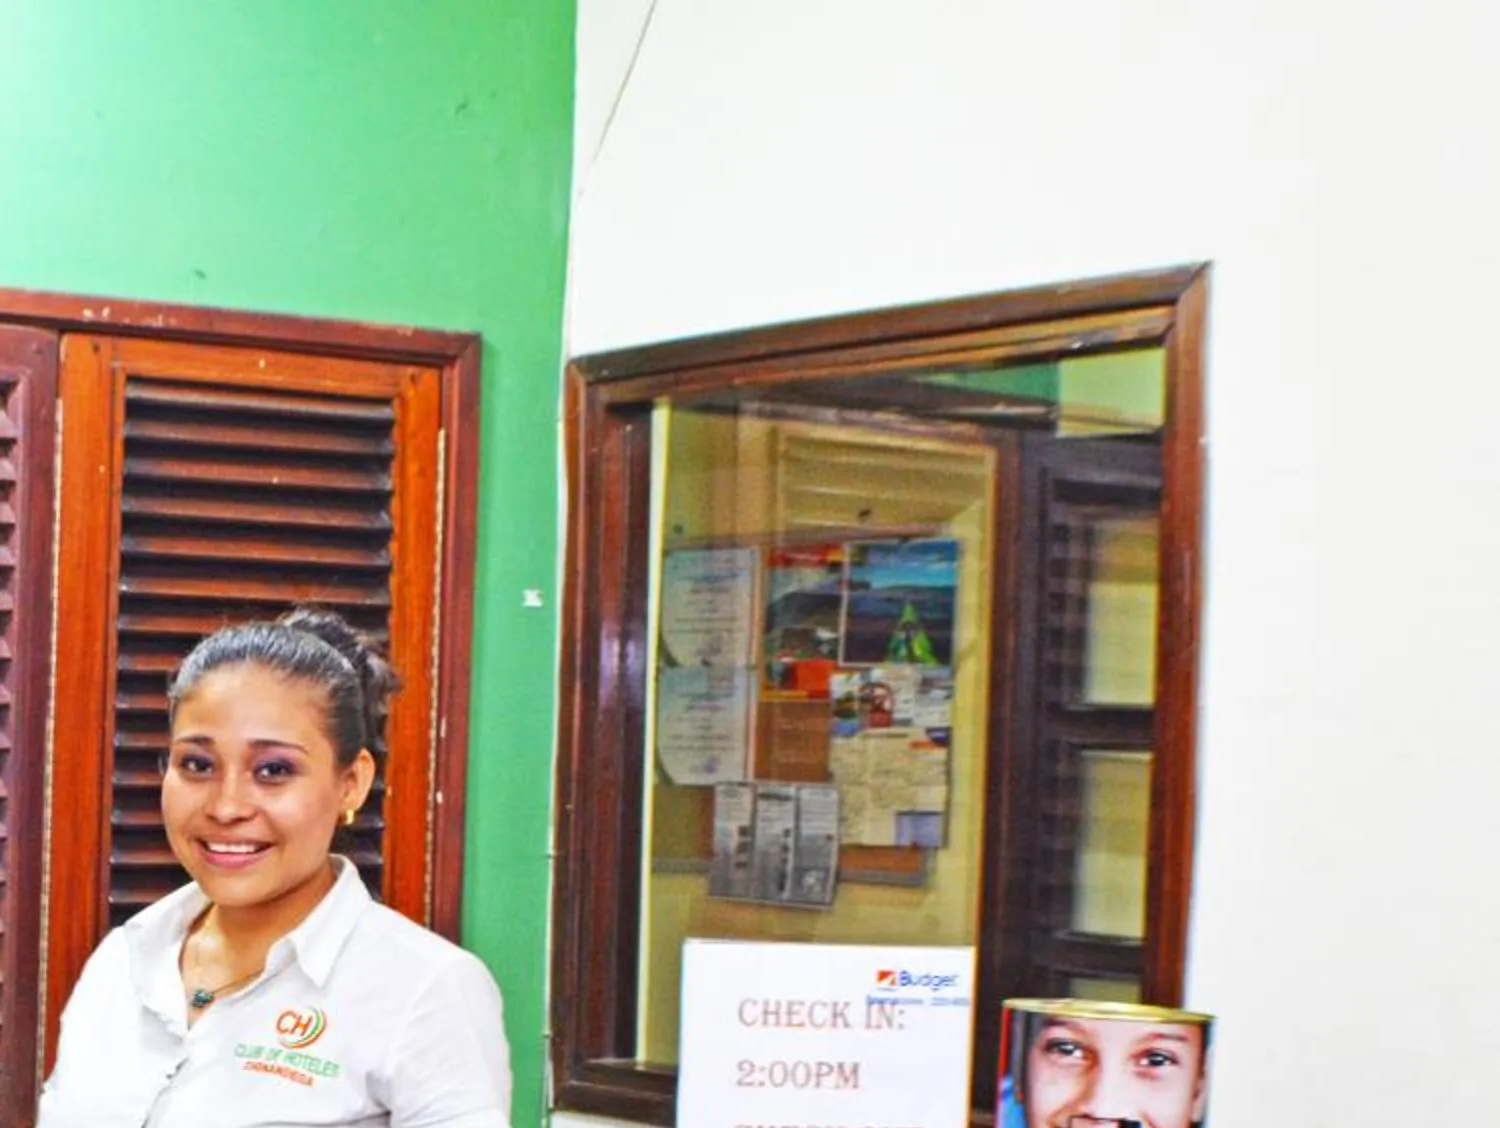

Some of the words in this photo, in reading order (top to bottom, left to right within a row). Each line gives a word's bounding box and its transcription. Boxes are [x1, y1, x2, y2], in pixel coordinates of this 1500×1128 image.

[276, 1010, 312, 1036] CH
[737, 998, 851, 1028] CHECK
[865, 1000, 905, 1030] IN:
[735, 1060, 860, 1089] 2:00PM
